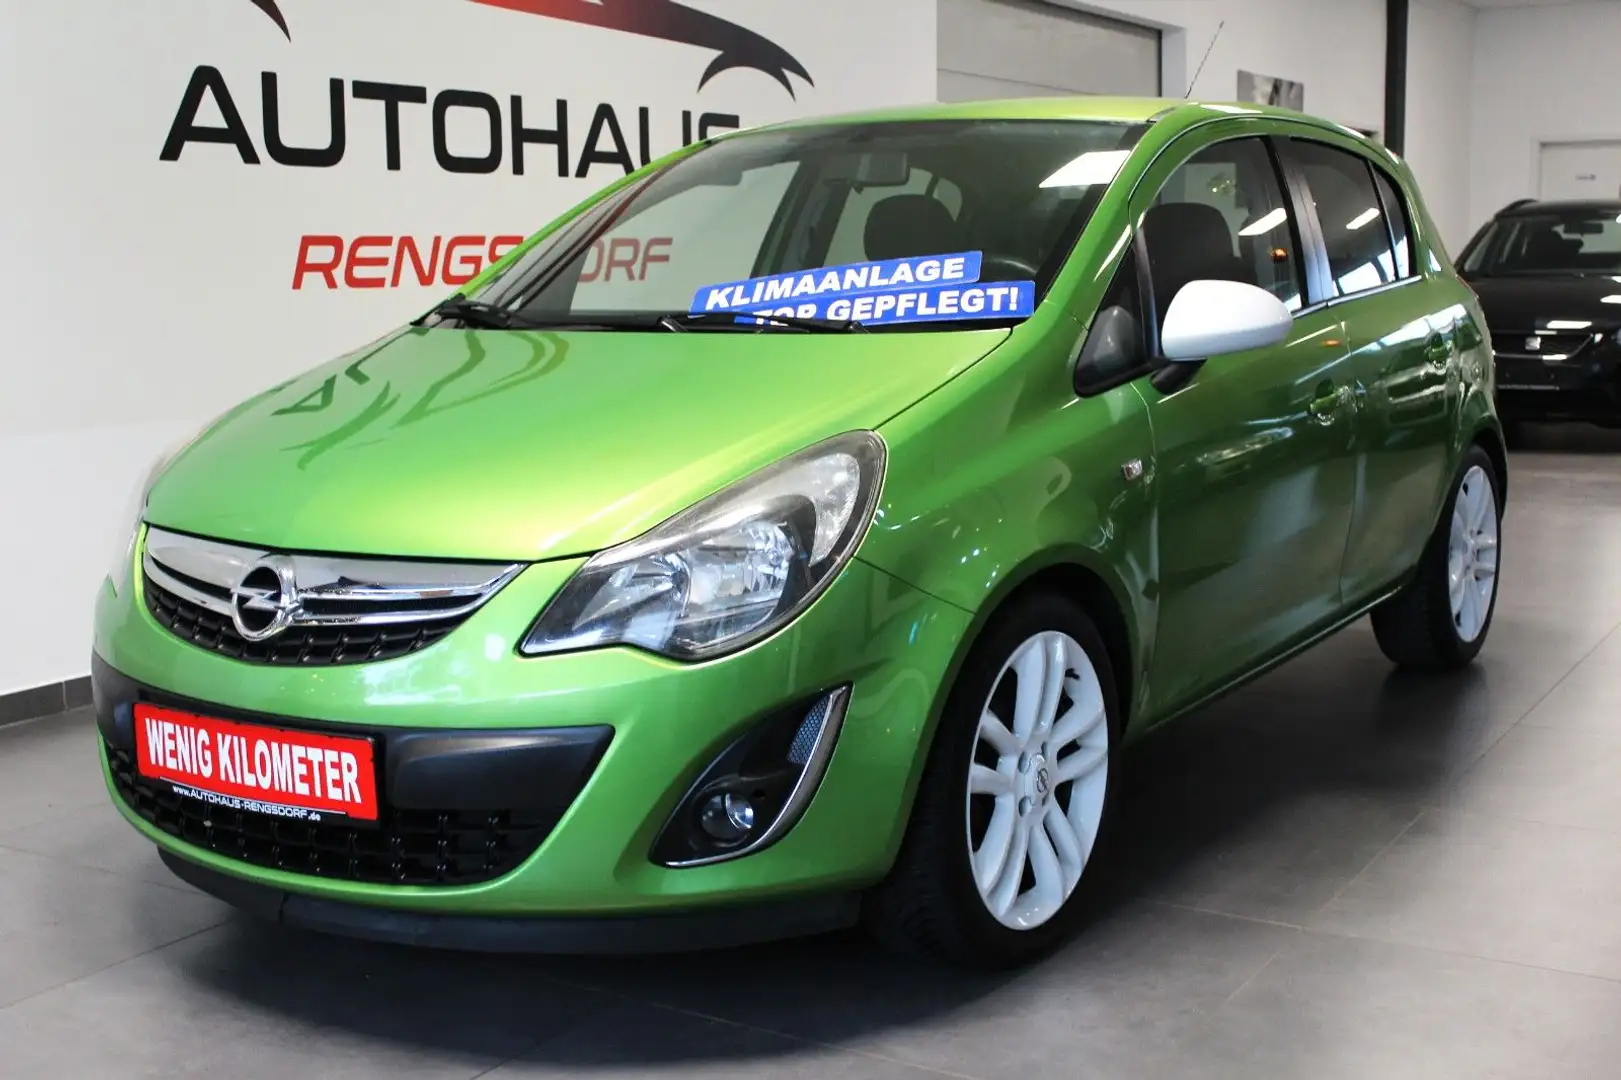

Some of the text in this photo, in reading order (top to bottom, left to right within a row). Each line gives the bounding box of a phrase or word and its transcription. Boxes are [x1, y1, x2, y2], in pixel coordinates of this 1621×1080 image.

[706, 258, 964, 310] KLIMAANLAGE
[826, 287, 1018, 321] GEPFLEGT!
[145, 718, 361, 803] WENIG KILOMETER
